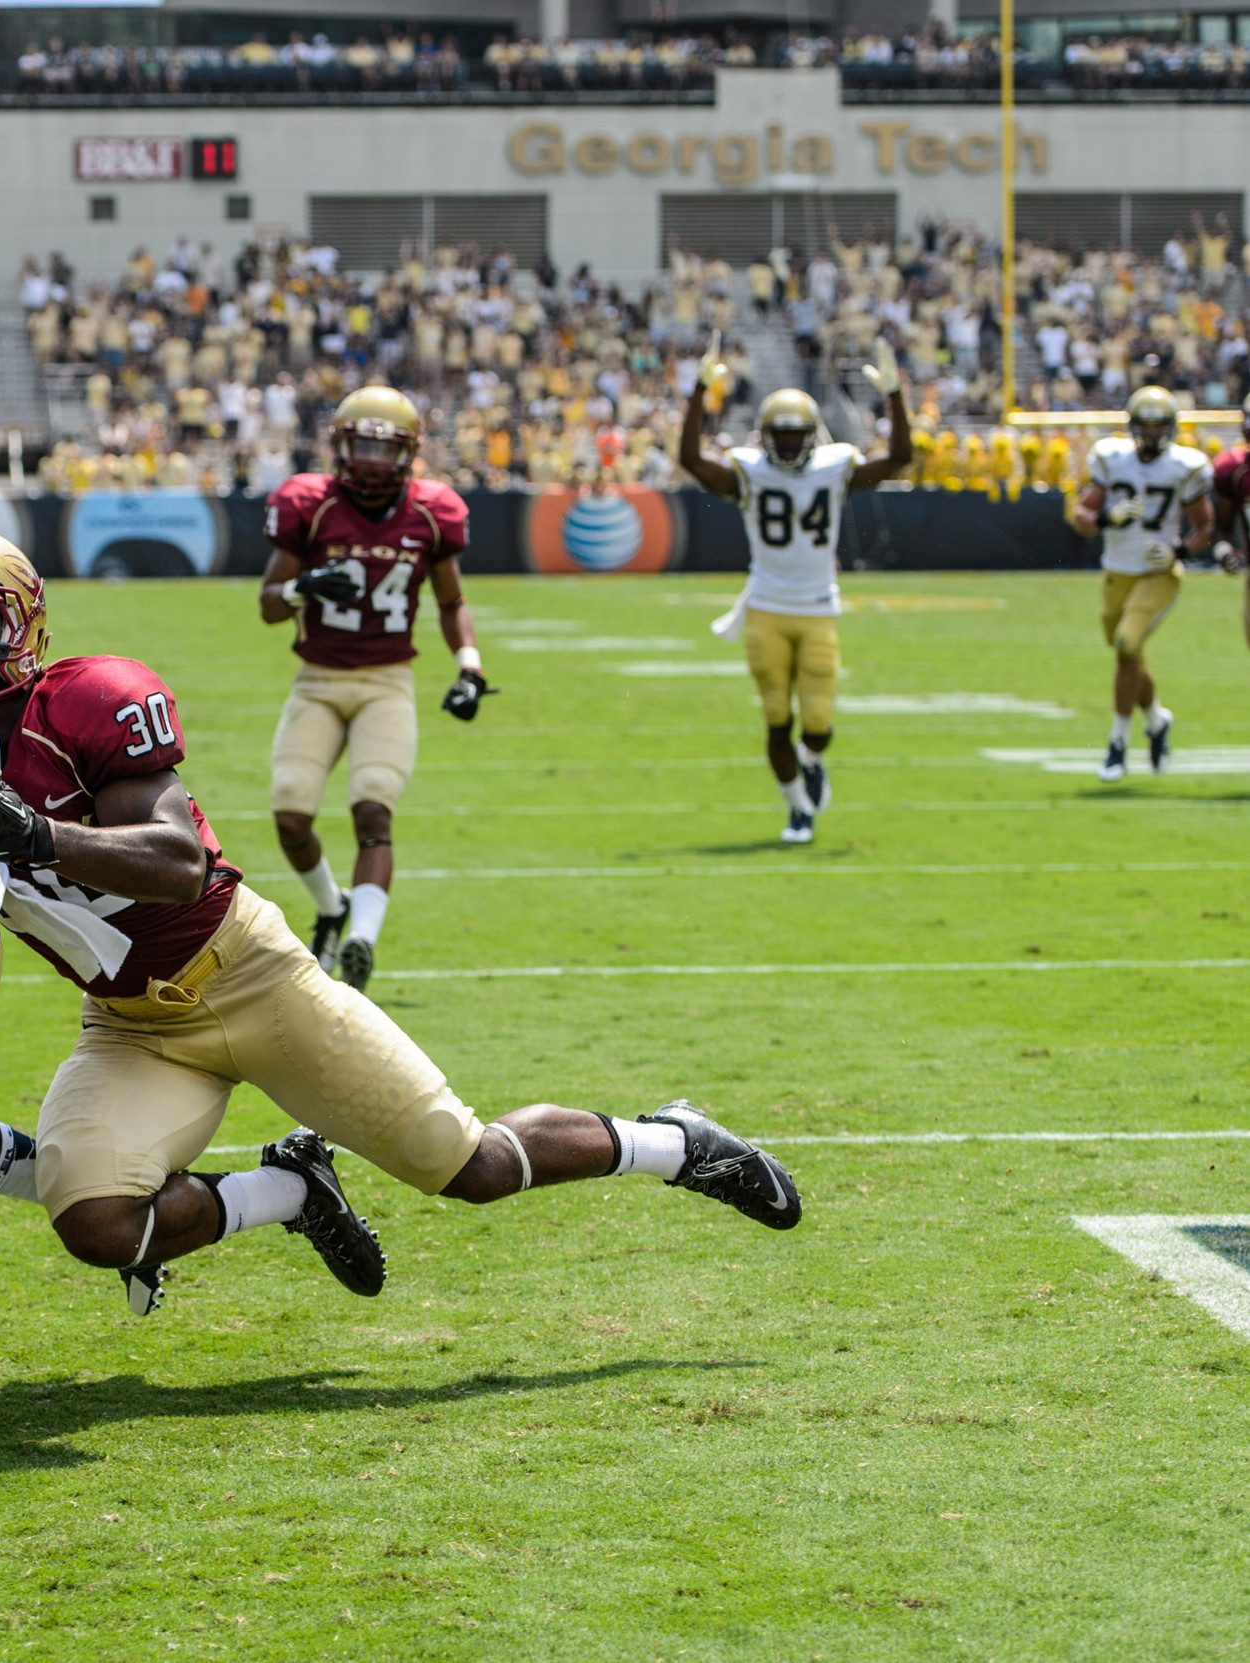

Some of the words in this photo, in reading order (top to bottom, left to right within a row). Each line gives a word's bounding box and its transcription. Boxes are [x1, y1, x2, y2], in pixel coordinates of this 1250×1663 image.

[508, 120, 834, 188] Georgia
[860, 120, 1048, 175] Tech
[757, 486, 831, 549] 84
[326, 543, 422, 565] ELON
[114, 690, 176, 758] 30
